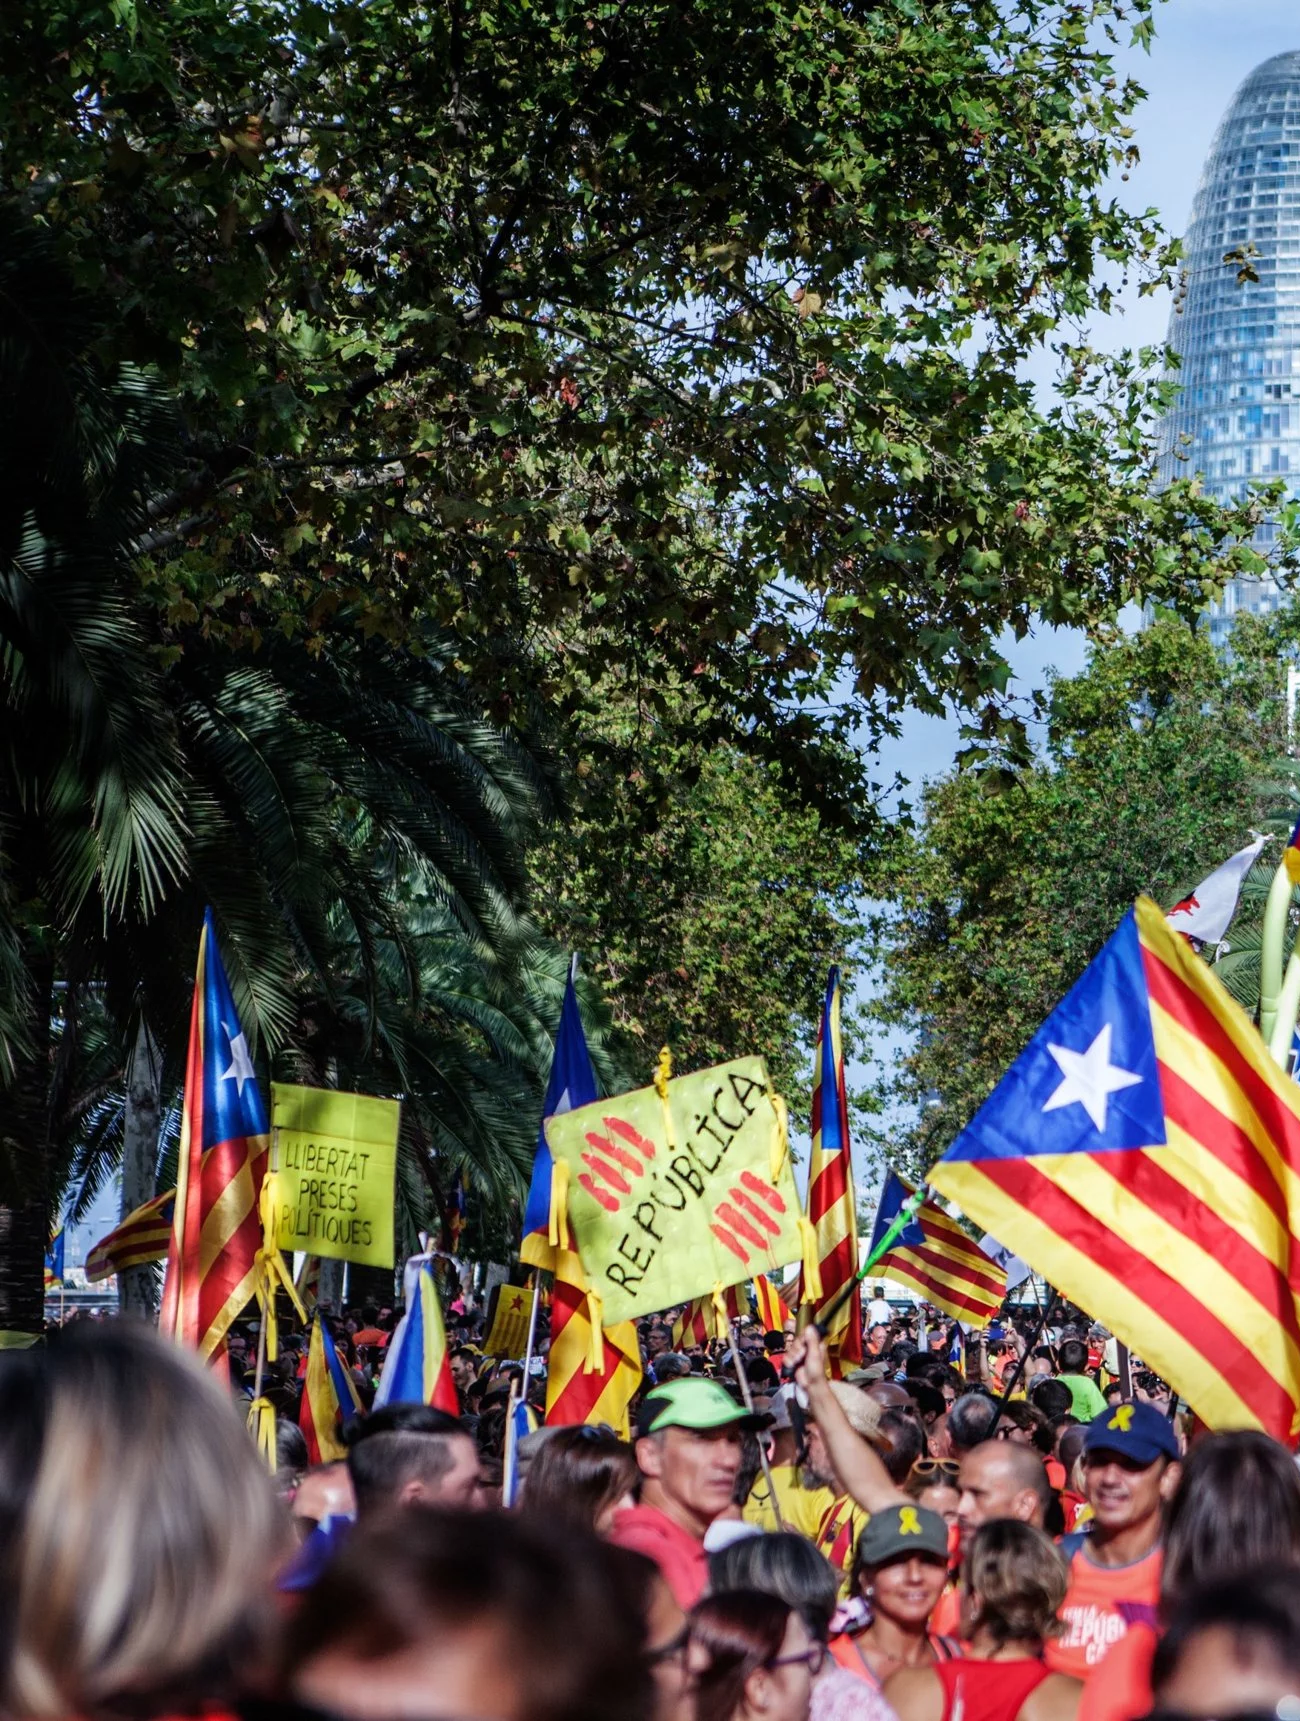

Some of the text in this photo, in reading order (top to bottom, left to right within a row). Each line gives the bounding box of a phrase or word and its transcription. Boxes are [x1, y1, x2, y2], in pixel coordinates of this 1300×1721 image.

[285, 1141, 370, 1181] LLIBERTAT
[299, 1178, 359, 1212] PRESES
[606, 1073, 767, 1297] REPÚBLICA
[281, 1204, 372, 1246] POLÍTIQUES
